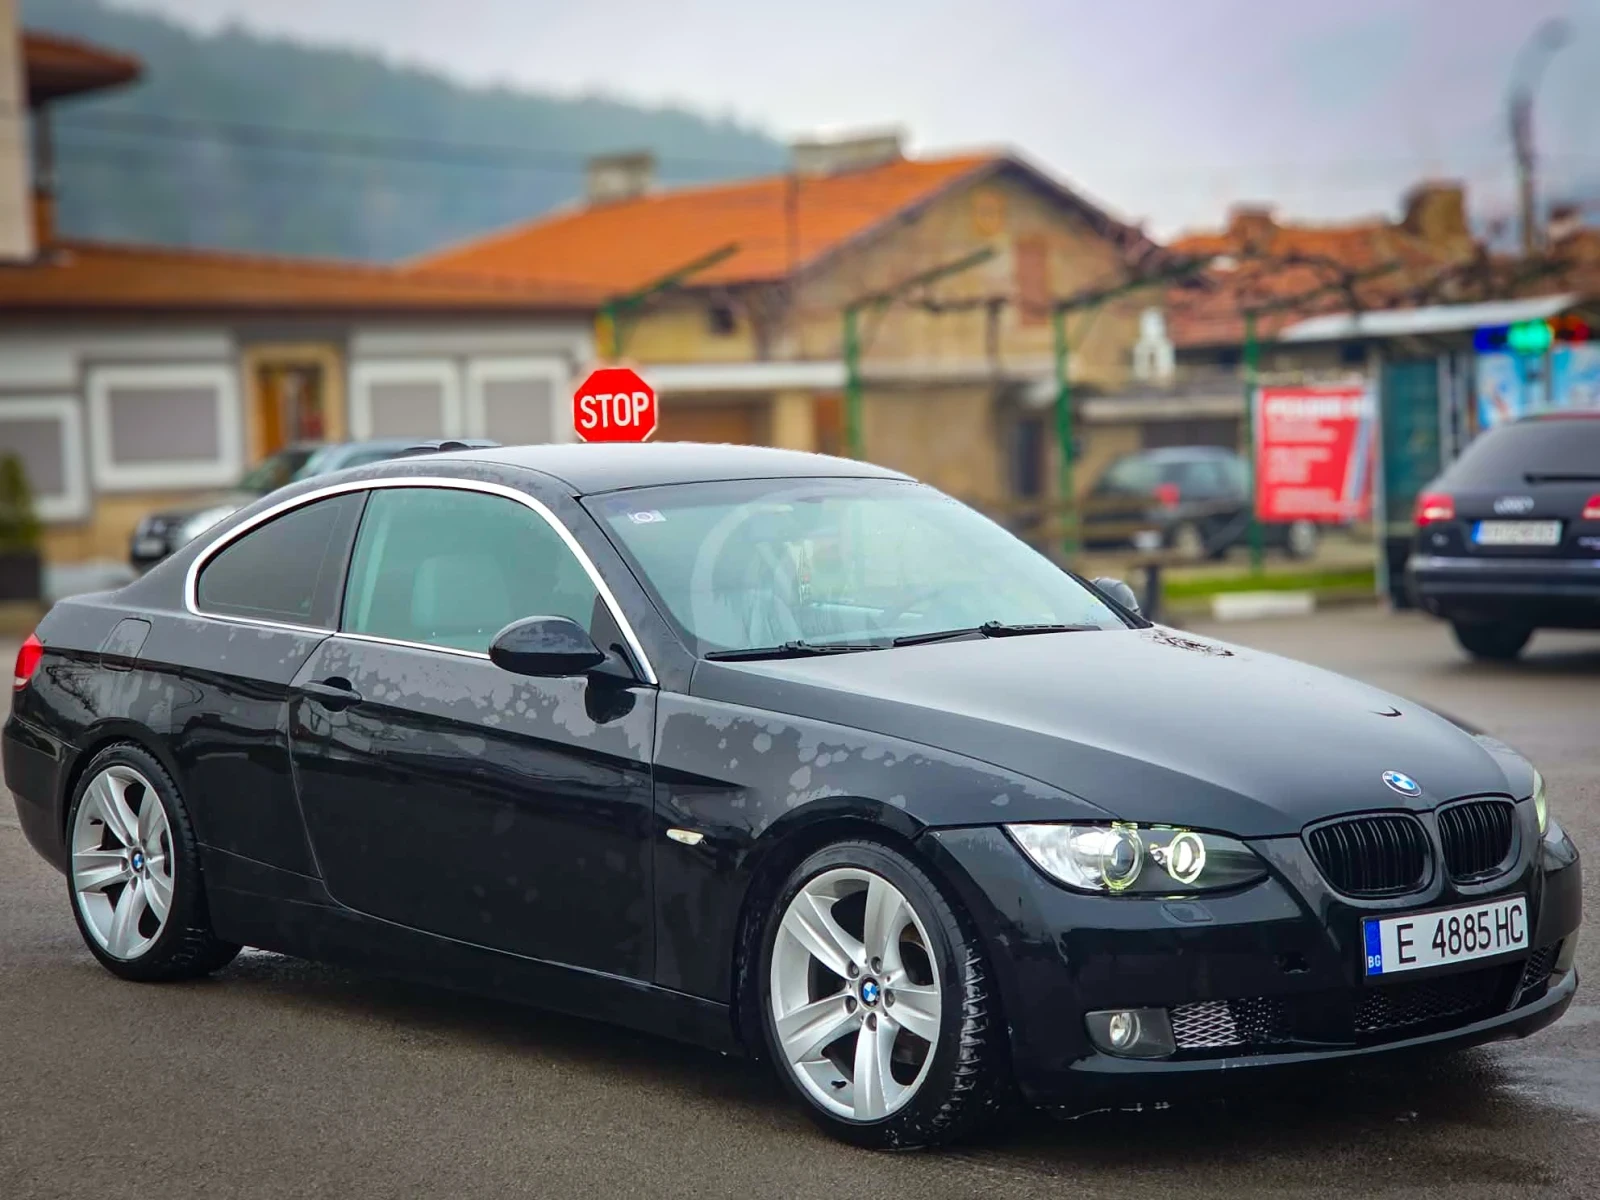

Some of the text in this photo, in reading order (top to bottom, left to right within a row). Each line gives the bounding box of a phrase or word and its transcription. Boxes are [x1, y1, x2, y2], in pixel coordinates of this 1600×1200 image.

[580, 391, 649, 429] STOP
[1396, 904, 1524, 965] E 4885 HC
[1367, 955, 1382, 969] BG
